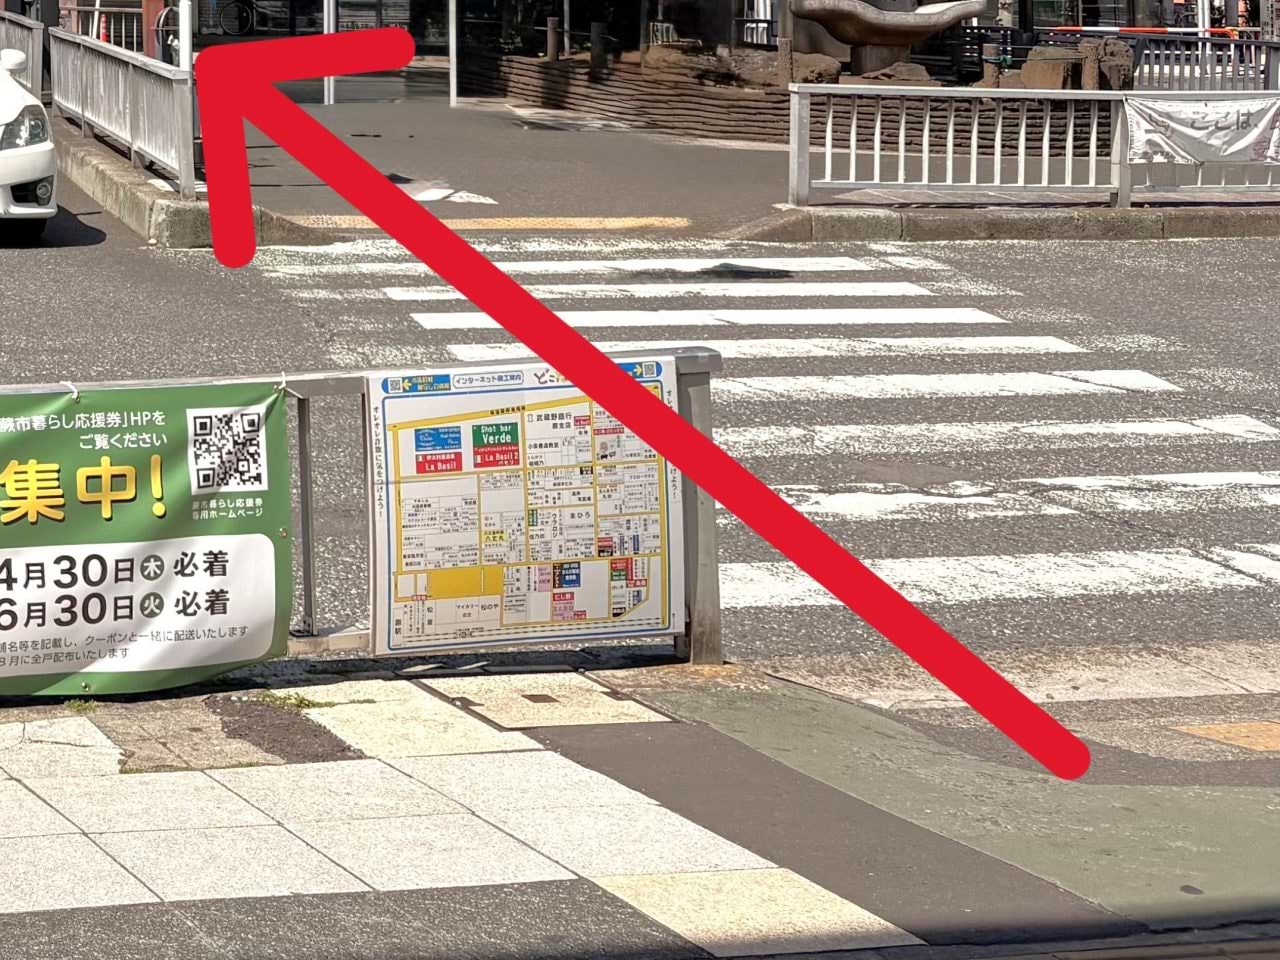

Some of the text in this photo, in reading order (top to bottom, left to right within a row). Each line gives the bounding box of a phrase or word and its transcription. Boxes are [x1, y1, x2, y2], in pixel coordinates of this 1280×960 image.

[79, 433, 168, 450] ご覧ください
[482, 433, 512, 444] Verde
[425, 462, 457, 471] La Basil
